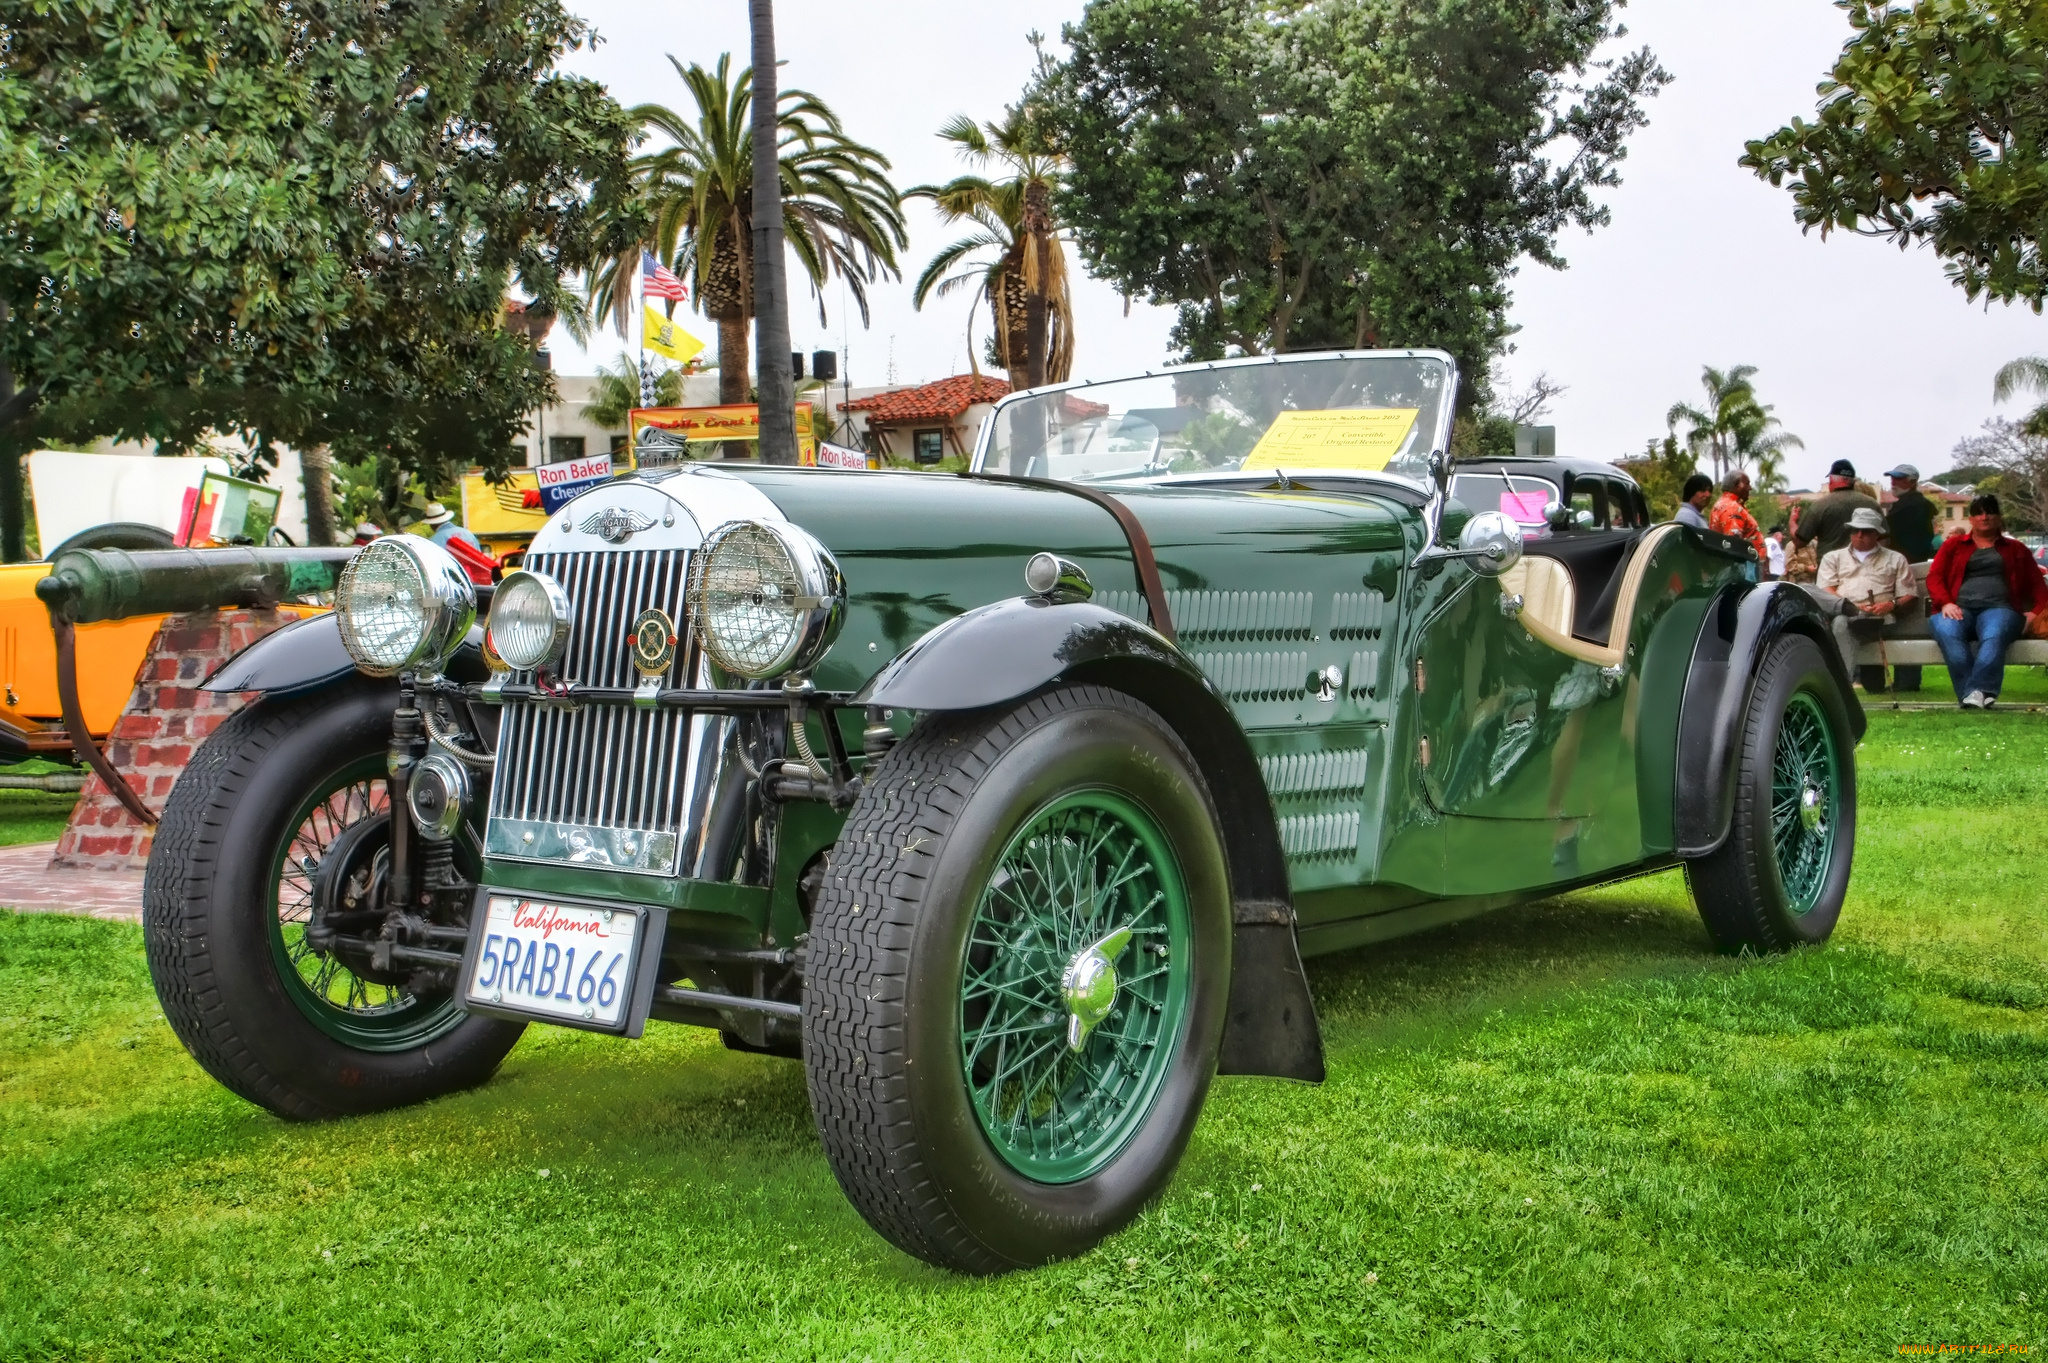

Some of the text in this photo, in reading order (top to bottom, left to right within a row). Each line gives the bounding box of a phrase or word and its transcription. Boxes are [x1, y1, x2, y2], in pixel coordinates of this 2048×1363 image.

[540, 461, 609, 485] Ron Baker
[821, 446, 840, 465] Ron
[841, 451, 865, 470] Baker
[513, 901, 609, 939] California
[479, 933, 624, 1007] 5RAB166
